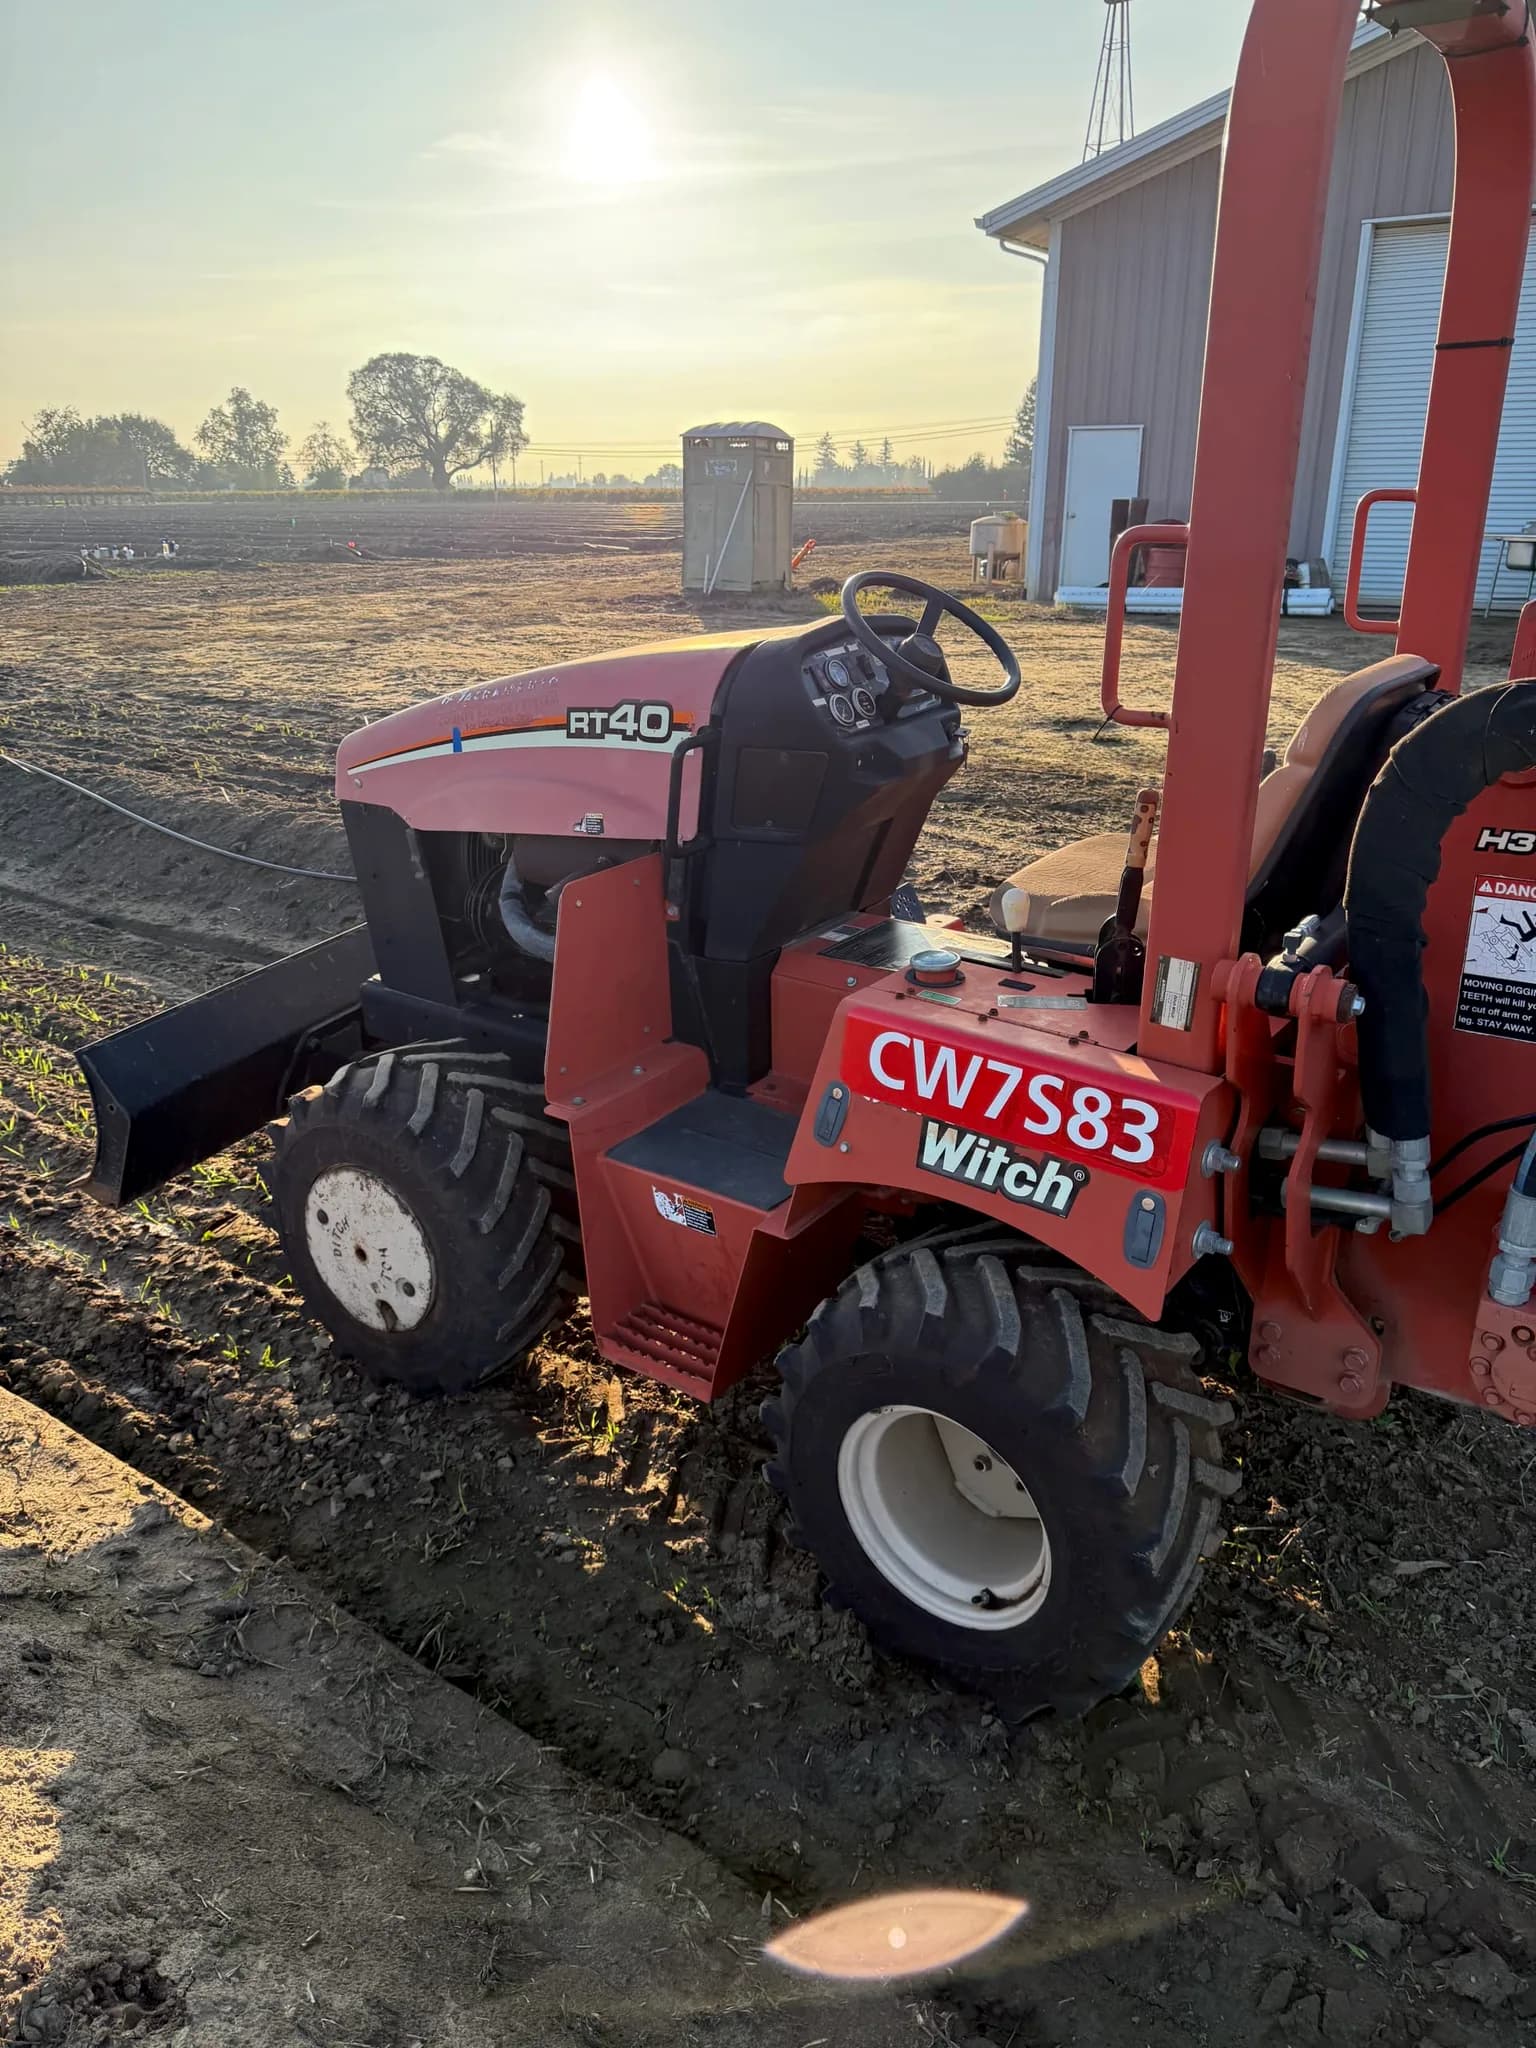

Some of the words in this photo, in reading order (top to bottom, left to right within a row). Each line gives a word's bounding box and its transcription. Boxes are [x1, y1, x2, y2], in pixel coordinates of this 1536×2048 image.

[569, 703, 670, 738] RT40
[1463, 978, 1503, 992] MOVING
[1462, 990, 1493, 1003] TEETH
[1495, 996, 1511, 1006] will
[1512, 999, 1526, 1008] kill
[1471, 1006, 1486, 1015] cut
[1488, 1008, 1501, 1017] off
[1502, 1011, 1520, 1020] arm
[1477, 1018, 1502, 1029] STAY
[1503, 1023, 1535, 1035] AWAY.
[868, 1031, 1159, 1164] CW7S83
